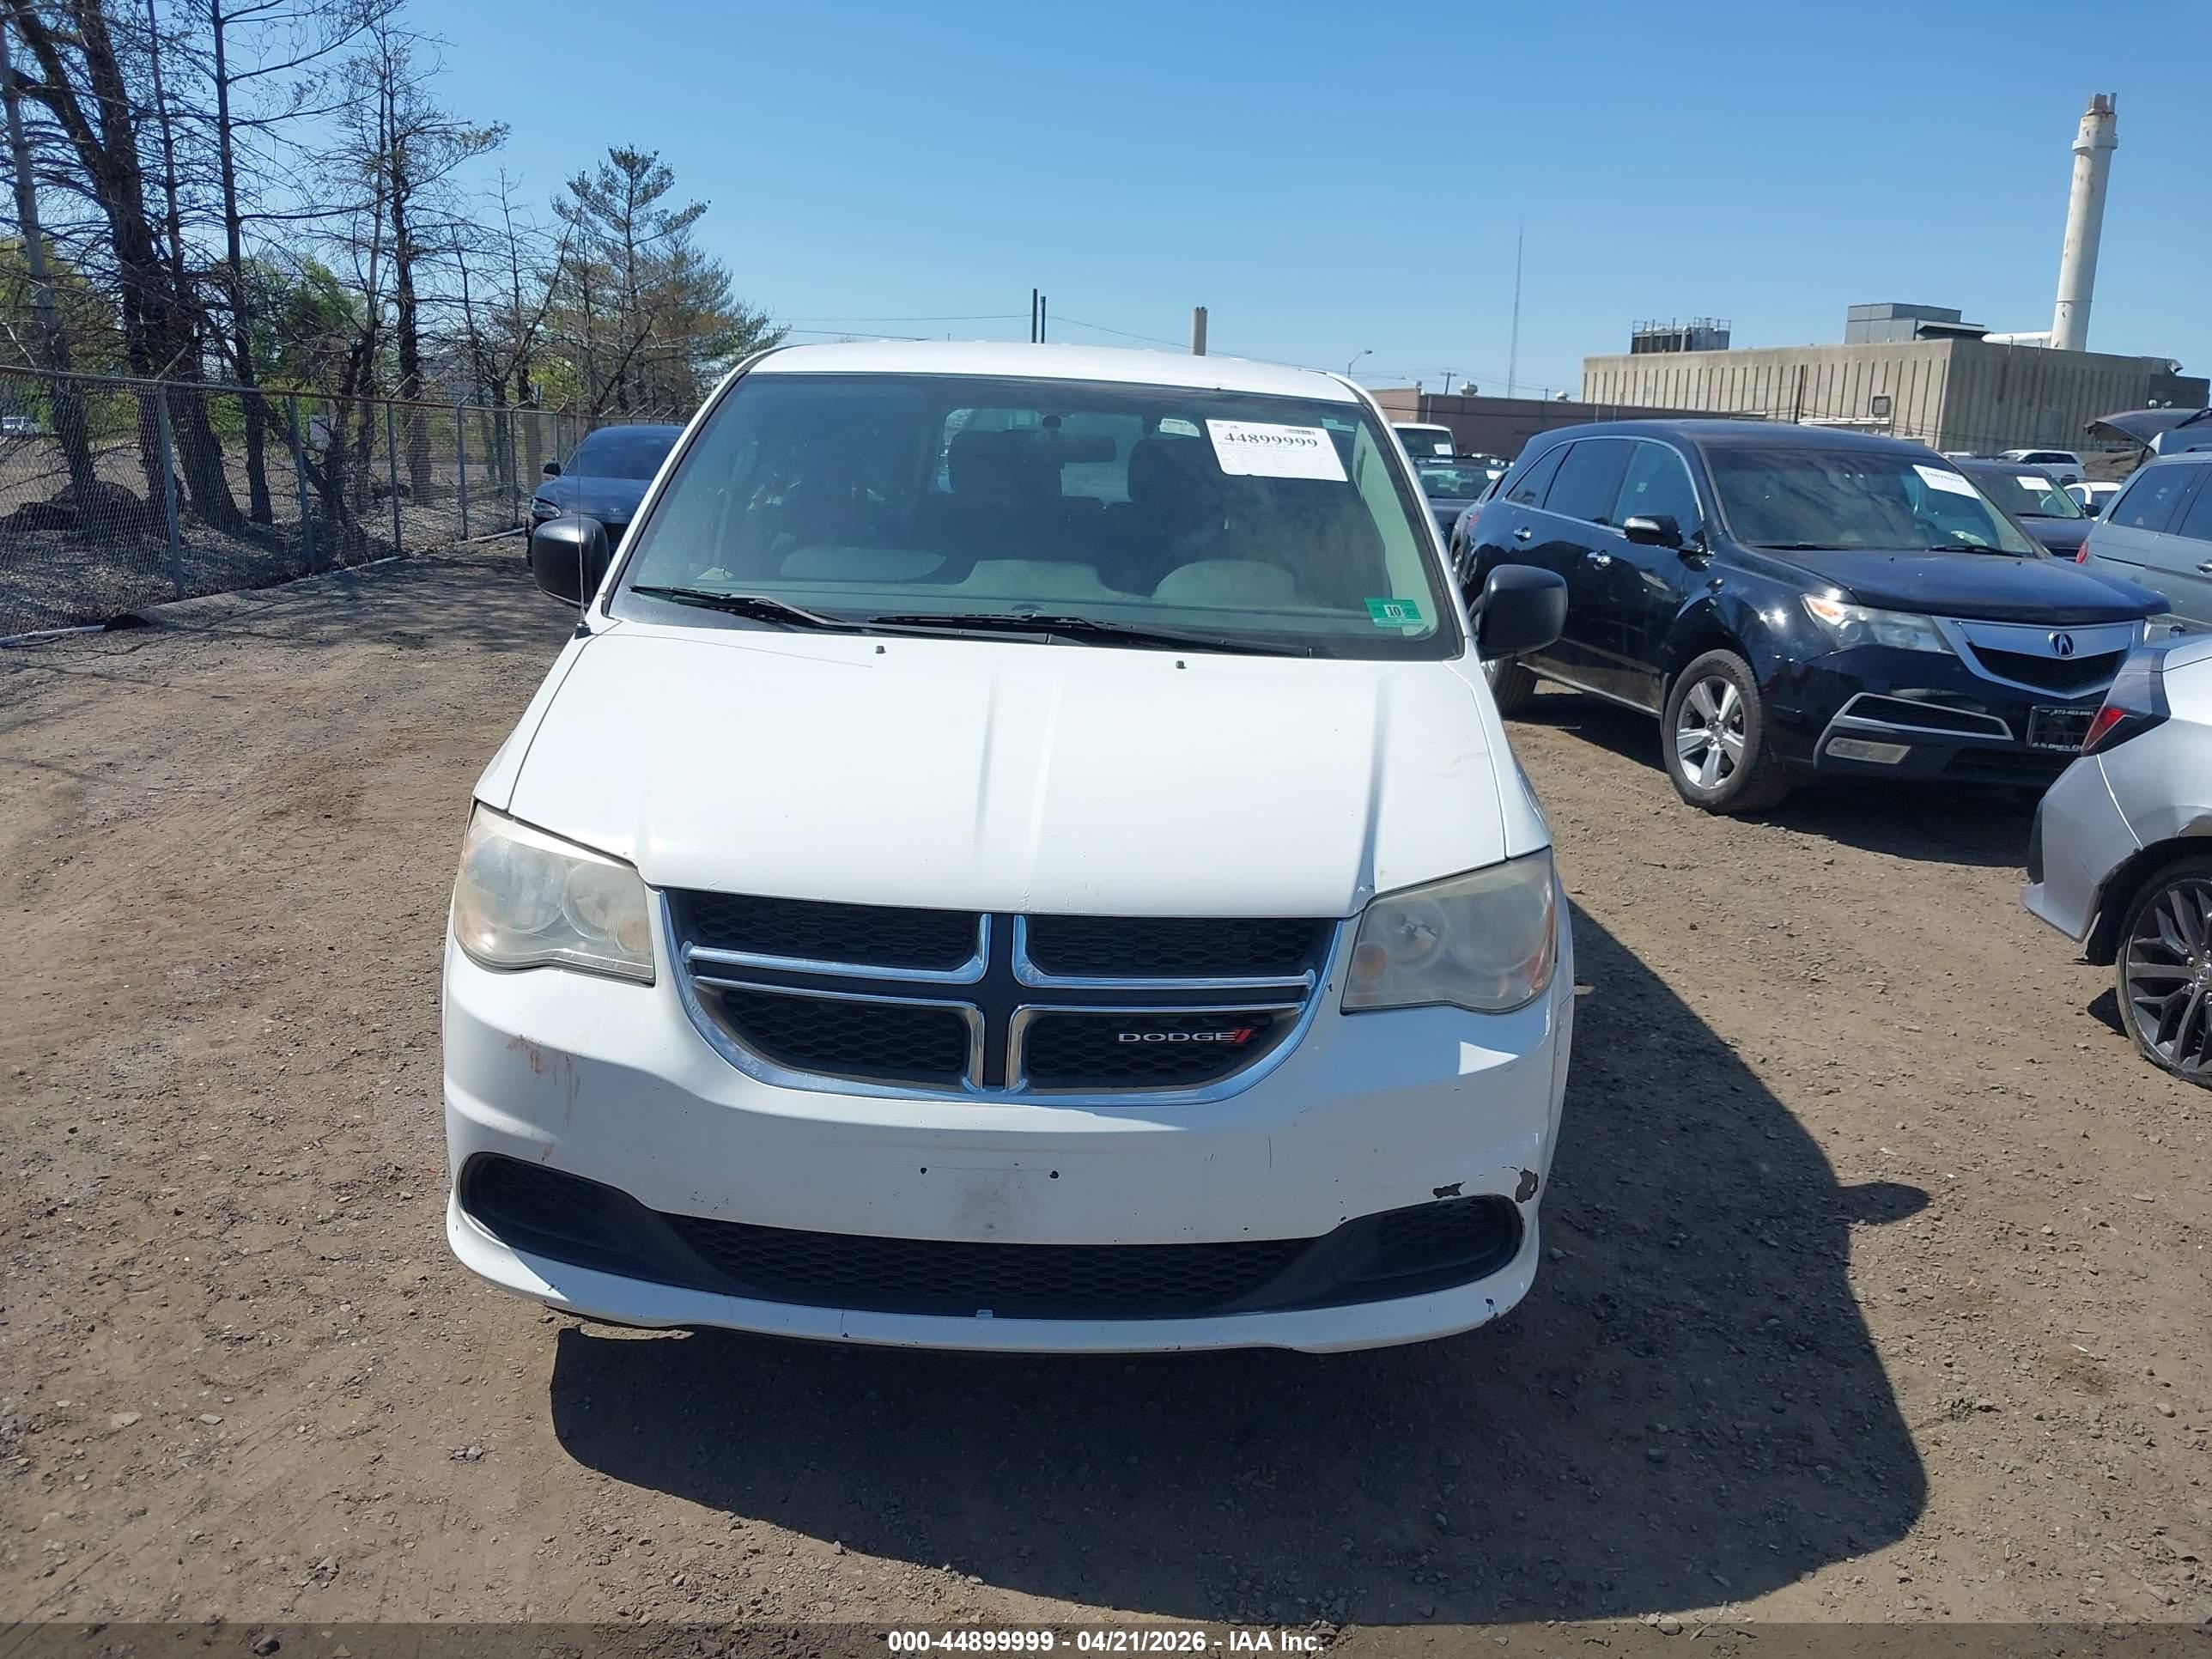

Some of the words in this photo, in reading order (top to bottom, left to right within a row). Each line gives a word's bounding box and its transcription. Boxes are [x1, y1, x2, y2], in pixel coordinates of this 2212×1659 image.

[1224, 432, 1318, 448] 44899999
[1387, 605, 1401, 617] 10
[1118, 1031, 1237, 1042] DODGE
